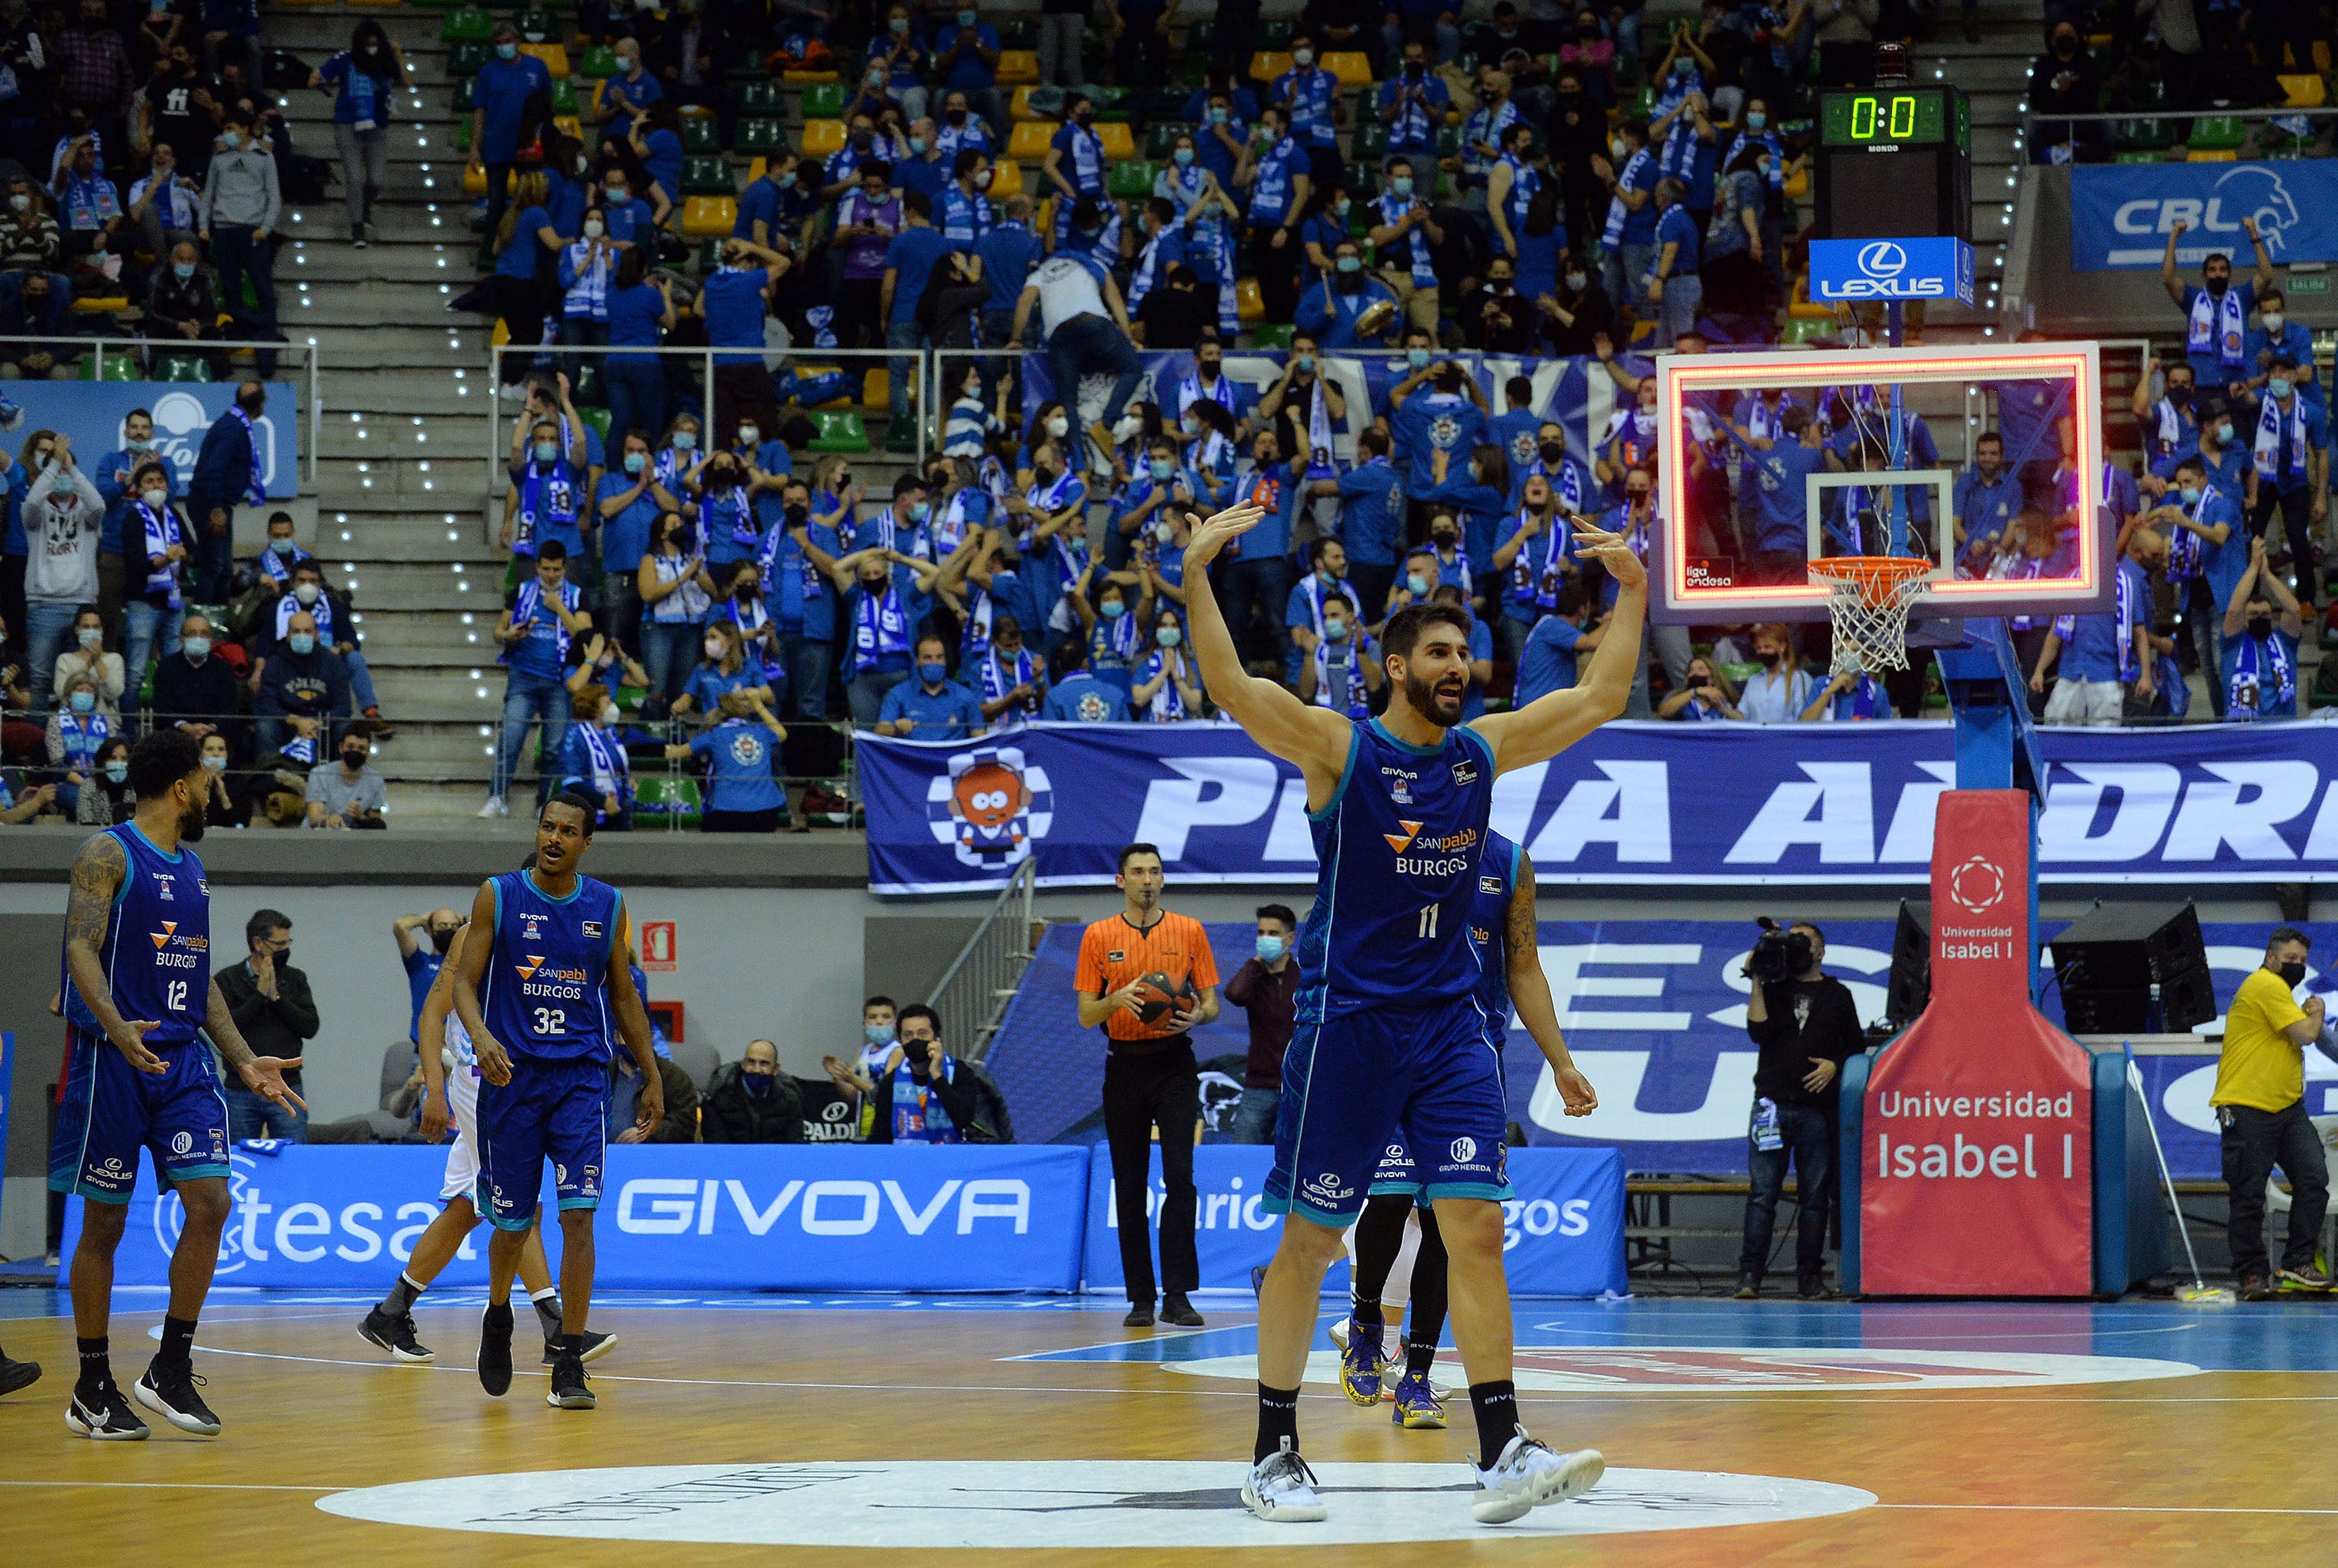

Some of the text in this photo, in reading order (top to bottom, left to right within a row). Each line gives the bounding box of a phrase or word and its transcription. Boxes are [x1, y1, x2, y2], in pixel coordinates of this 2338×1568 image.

[1851, 97, 1916, 139] 0:0
[2114, 198, 2240, 234] CBL
[1821, 278, 1945, 297] LEXUS
[1687, 565, 1708, 578] liga
[1687, 575, 1732, 587] endesa
[1395, 855, 1467, 877] BURGOS
[1418, 902, 1439, 939] 11
[1941, 926, 2012, 938] Universidad
[1941, 941, 1999, 959] Isabel
[156, 951, 197, 970] BURGOS
[168, 980, 188, 1012] 12
[523, 982, 581, 1000] BURGOS
[533, 1007, 565, 1035] 32
[1880, 1090, 2073, 1118] Universidad
[803, 1120, 856, 1141] PALDI
[1378, 1158, 1416, 1167] EXUS
[1879, 1133, 2038, 1179] Isabel
[89, 1163, 133, 1180] LEXUS
[1460, 1164, 1491, 1172] HEREDA
[86, 1175, 117, 1190] GIVOVA
[1302, 1177, 1355, 1199] LEXUS
[617, 1179, 1030, 1236] GIVOVA
[1302, 1190, 1338, 1210] GIVOVA
